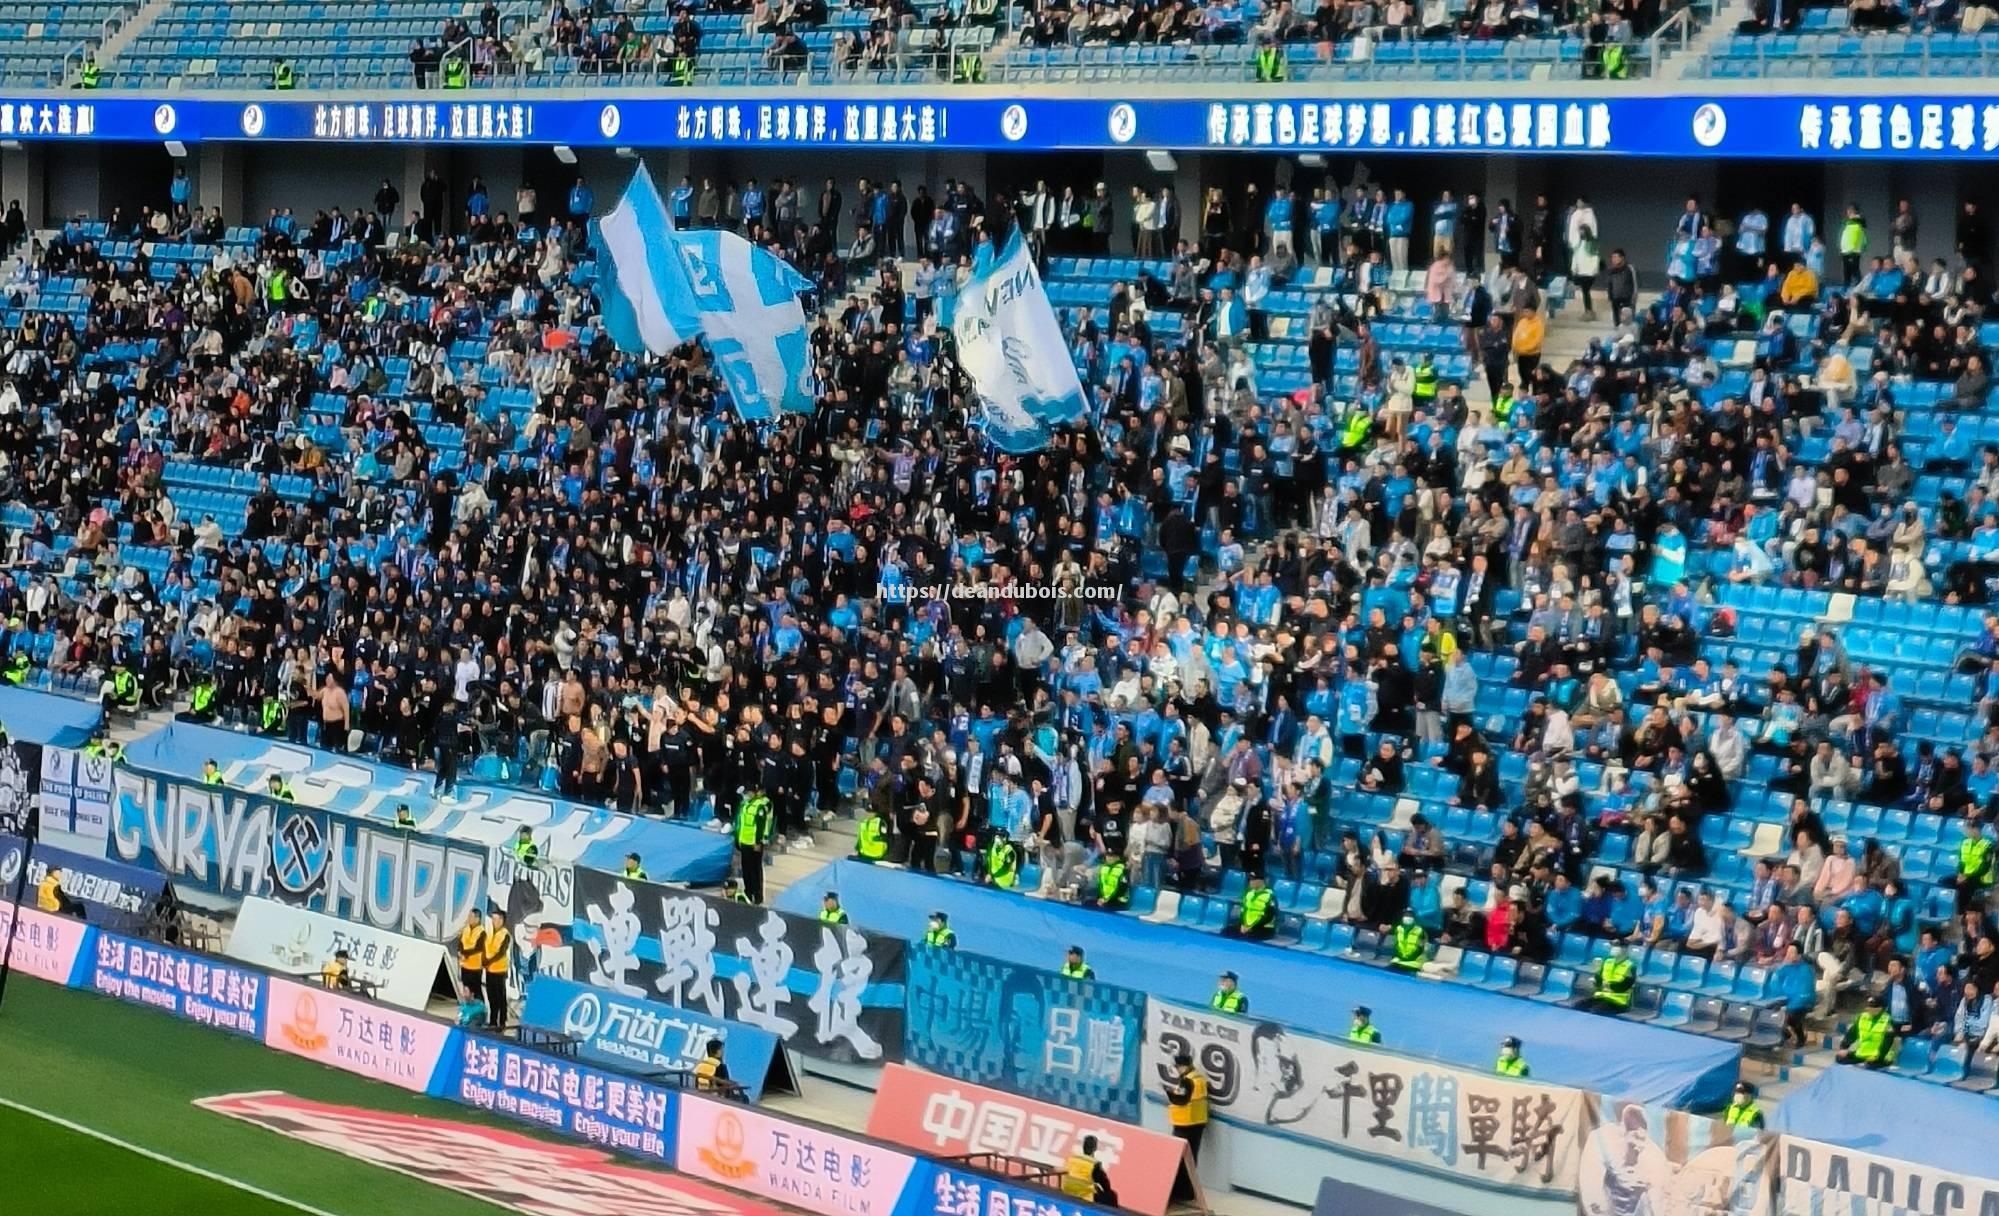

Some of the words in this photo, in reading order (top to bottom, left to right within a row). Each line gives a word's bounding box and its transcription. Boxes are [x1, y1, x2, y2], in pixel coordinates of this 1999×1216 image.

[112, 768, 274, 897] CURVA
[325, 822, 484, 943] NORD
[96, 970, 123, 996] Enjoy
[123, 978, 140, 1000] the
[141, 986, 176, 1011] movies
[185, 995, 213, 1025] Enjoy
[213, 1006, 237, 1027] your
[239, 1011, 255, 1034] life
[338, 1007, 416, 1055] 万达电影
[337, 1045, 378, 1069] WANDA
[385, 1058, 415, 1079] FILM
[653, 1053, 695, 1070] PLAZ
[1157, 1032, 1240, 1106] 39
[463, 1078, 495, 1109] Enjoy
[497, 1089, 517, 1113] the
[519, 1098, 563, 1126] movies
[575, 1111, 610, 1145] Enjoy
[611, 1127, 640, 1149] your
[643, 1131, 664, 1158] life
[770, 1130, 871, 1188] 万达电影
[768, 1173, 822, 1202] WANDA
[832, 1189, 871, 1216] FILM
